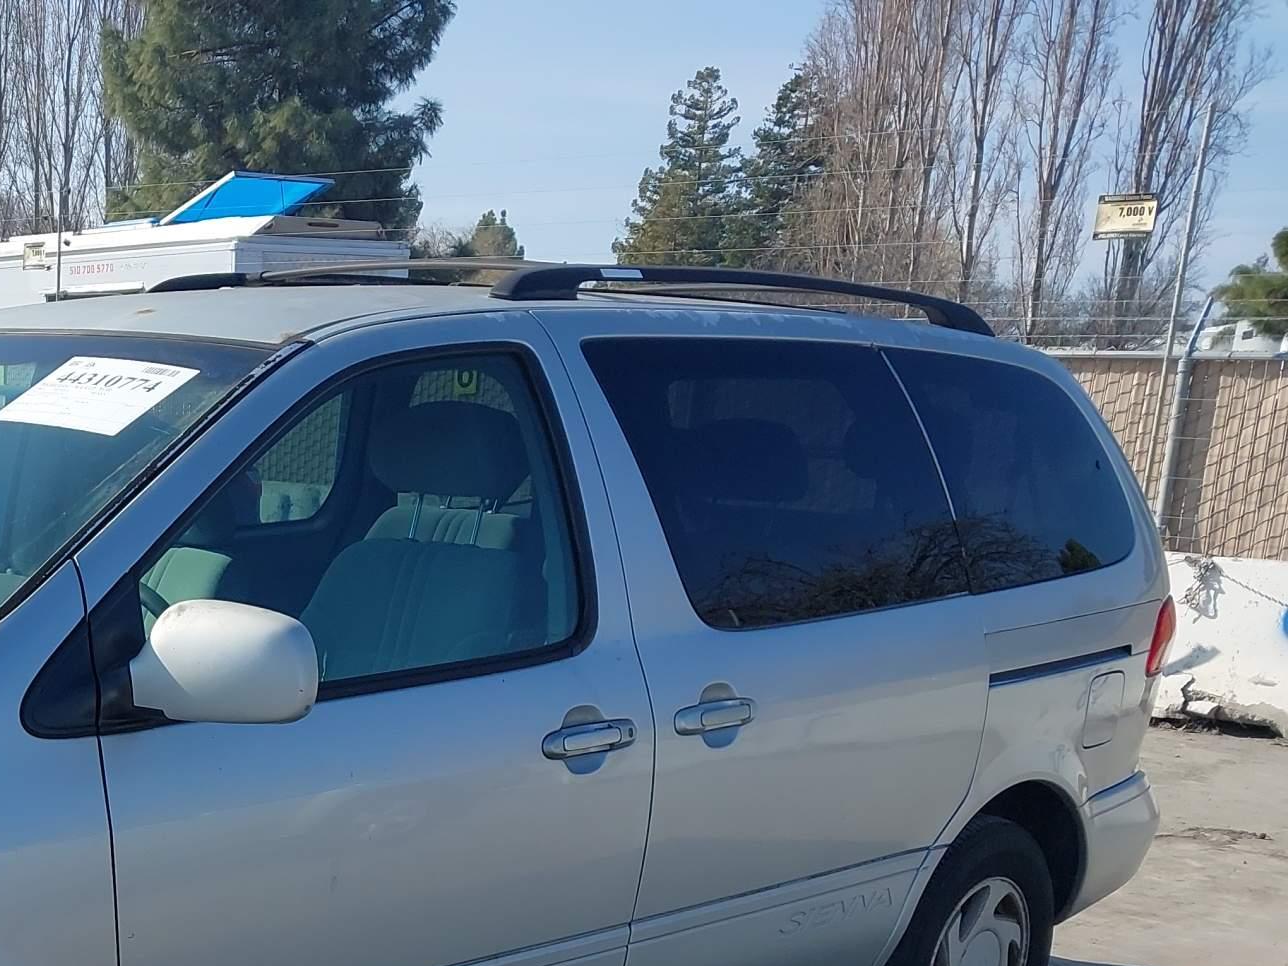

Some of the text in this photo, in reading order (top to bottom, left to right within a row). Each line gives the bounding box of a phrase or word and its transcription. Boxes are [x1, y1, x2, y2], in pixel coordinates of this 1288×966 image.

[1118, 206, 1155, 218] 7,000 V
[56, 371, 163, 393] 44310774
